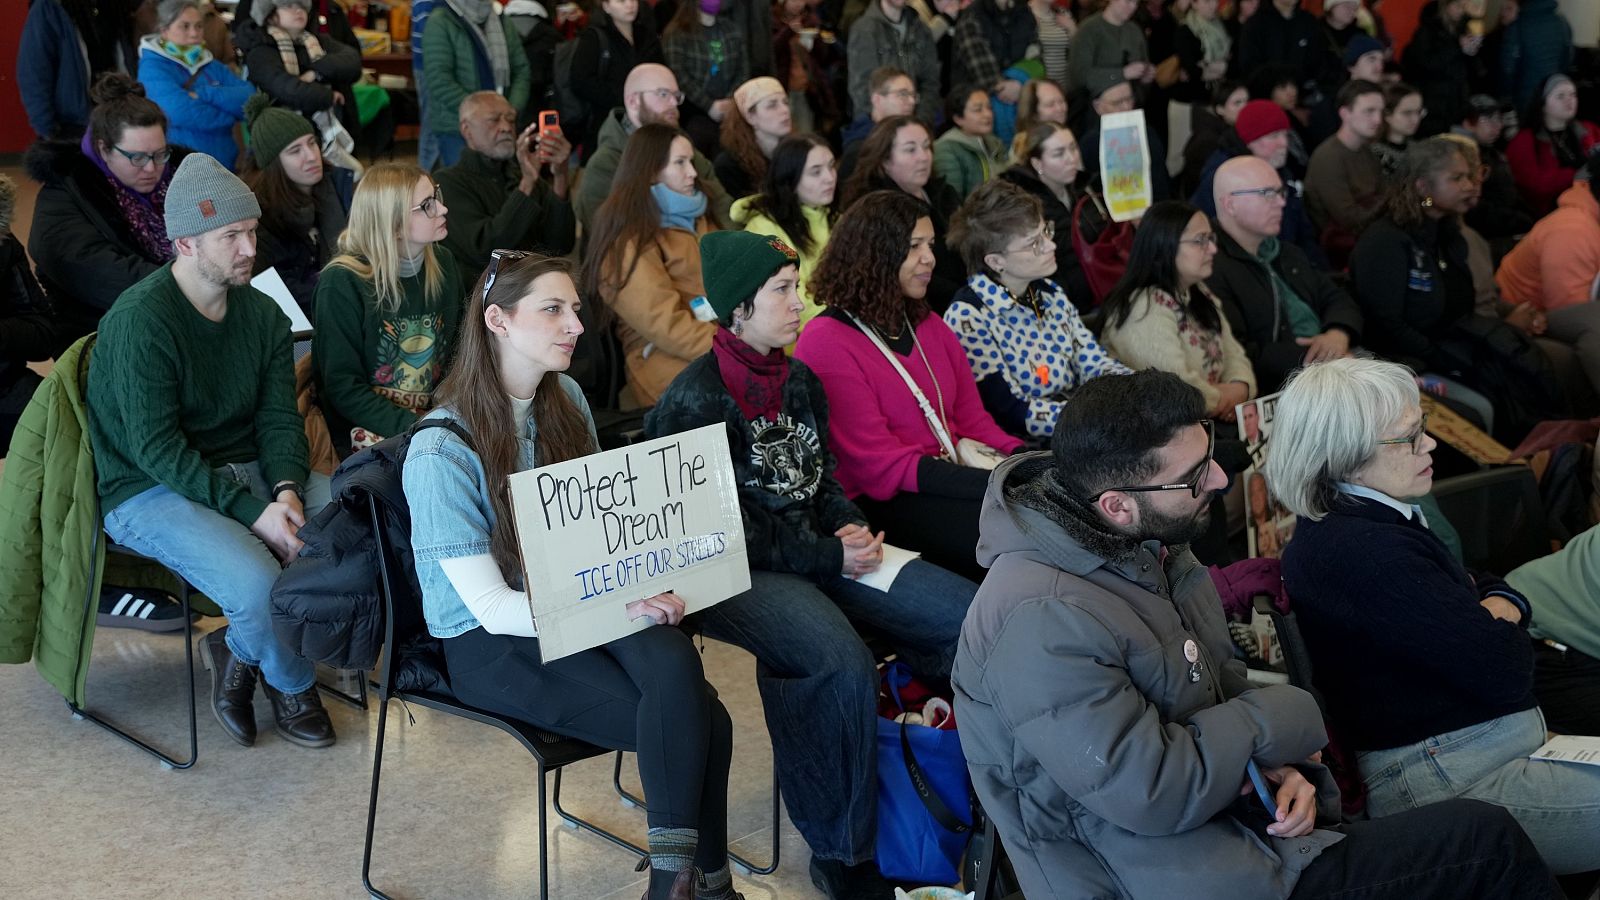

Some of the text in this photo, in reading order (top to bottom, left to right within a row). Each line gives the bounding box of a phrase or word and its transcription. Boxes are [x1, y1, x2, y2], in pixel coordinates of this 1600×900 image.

[796, 422, 820, 454] BITE
[537, 454, 638, 531] Protect
[648, 441, 707, 498] The
[602, 501, 686, 555] Dream
[575, 532, 726, 600] ICE OFF OUR STREETS
